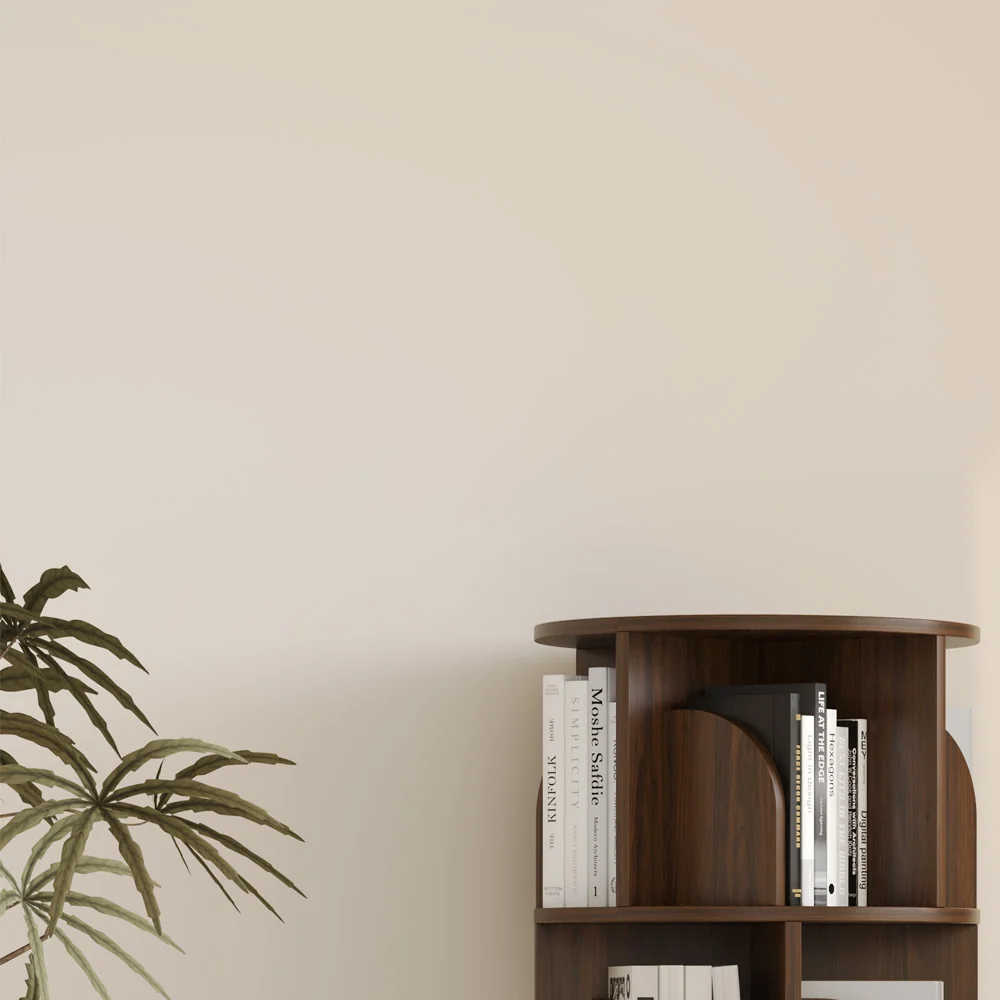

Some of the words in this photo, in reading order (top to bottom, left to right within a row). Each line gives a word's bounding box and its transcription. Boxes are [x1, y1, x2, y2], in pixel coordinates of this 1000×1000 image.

[591, 688, 603, 747] Moshe
[818, 714, 825, 731] AT
[571, 697, 580, 809] SIMPLICITY
[591, 752, 604, 806] Safdie
[828, 733, 836, 797] Hexagons
[547, 755, 557, 823] KINFOLK
[860, 810, 868, 844] Digital
[859, 847, 867, 890] painting
